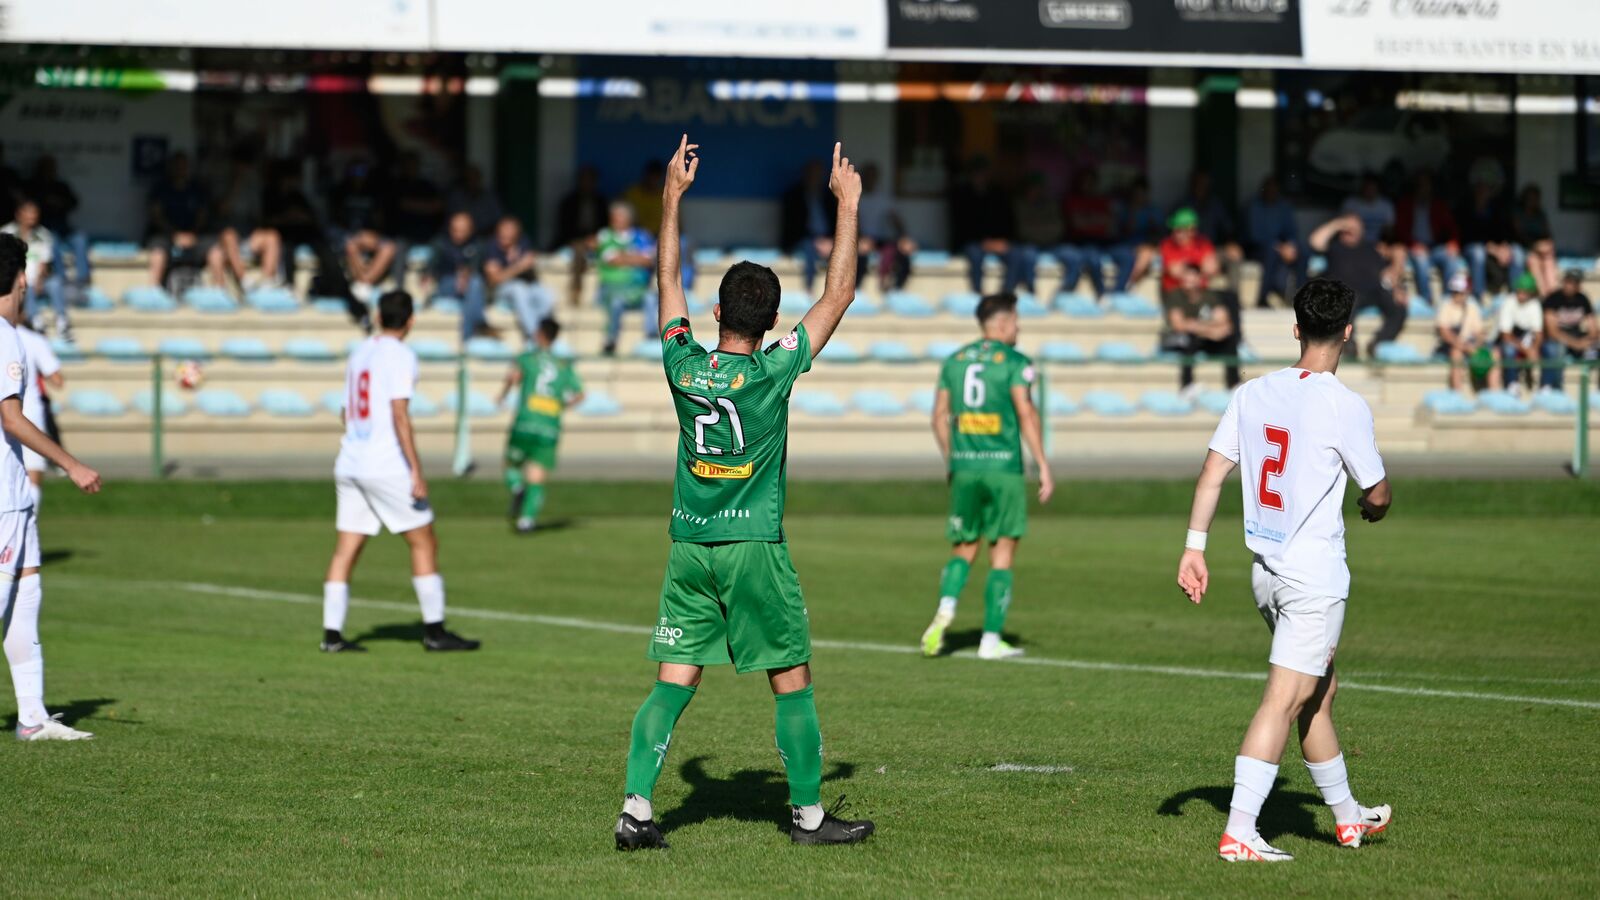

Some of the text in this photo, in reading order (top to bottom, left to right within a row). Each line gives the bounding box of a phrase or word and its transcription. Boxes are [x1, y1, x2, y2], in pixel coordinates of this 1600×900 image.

[963, 363, 986, 407] 6
[687, 394, 746, 455] 21
[1258, 424, 1291, 511] 2
